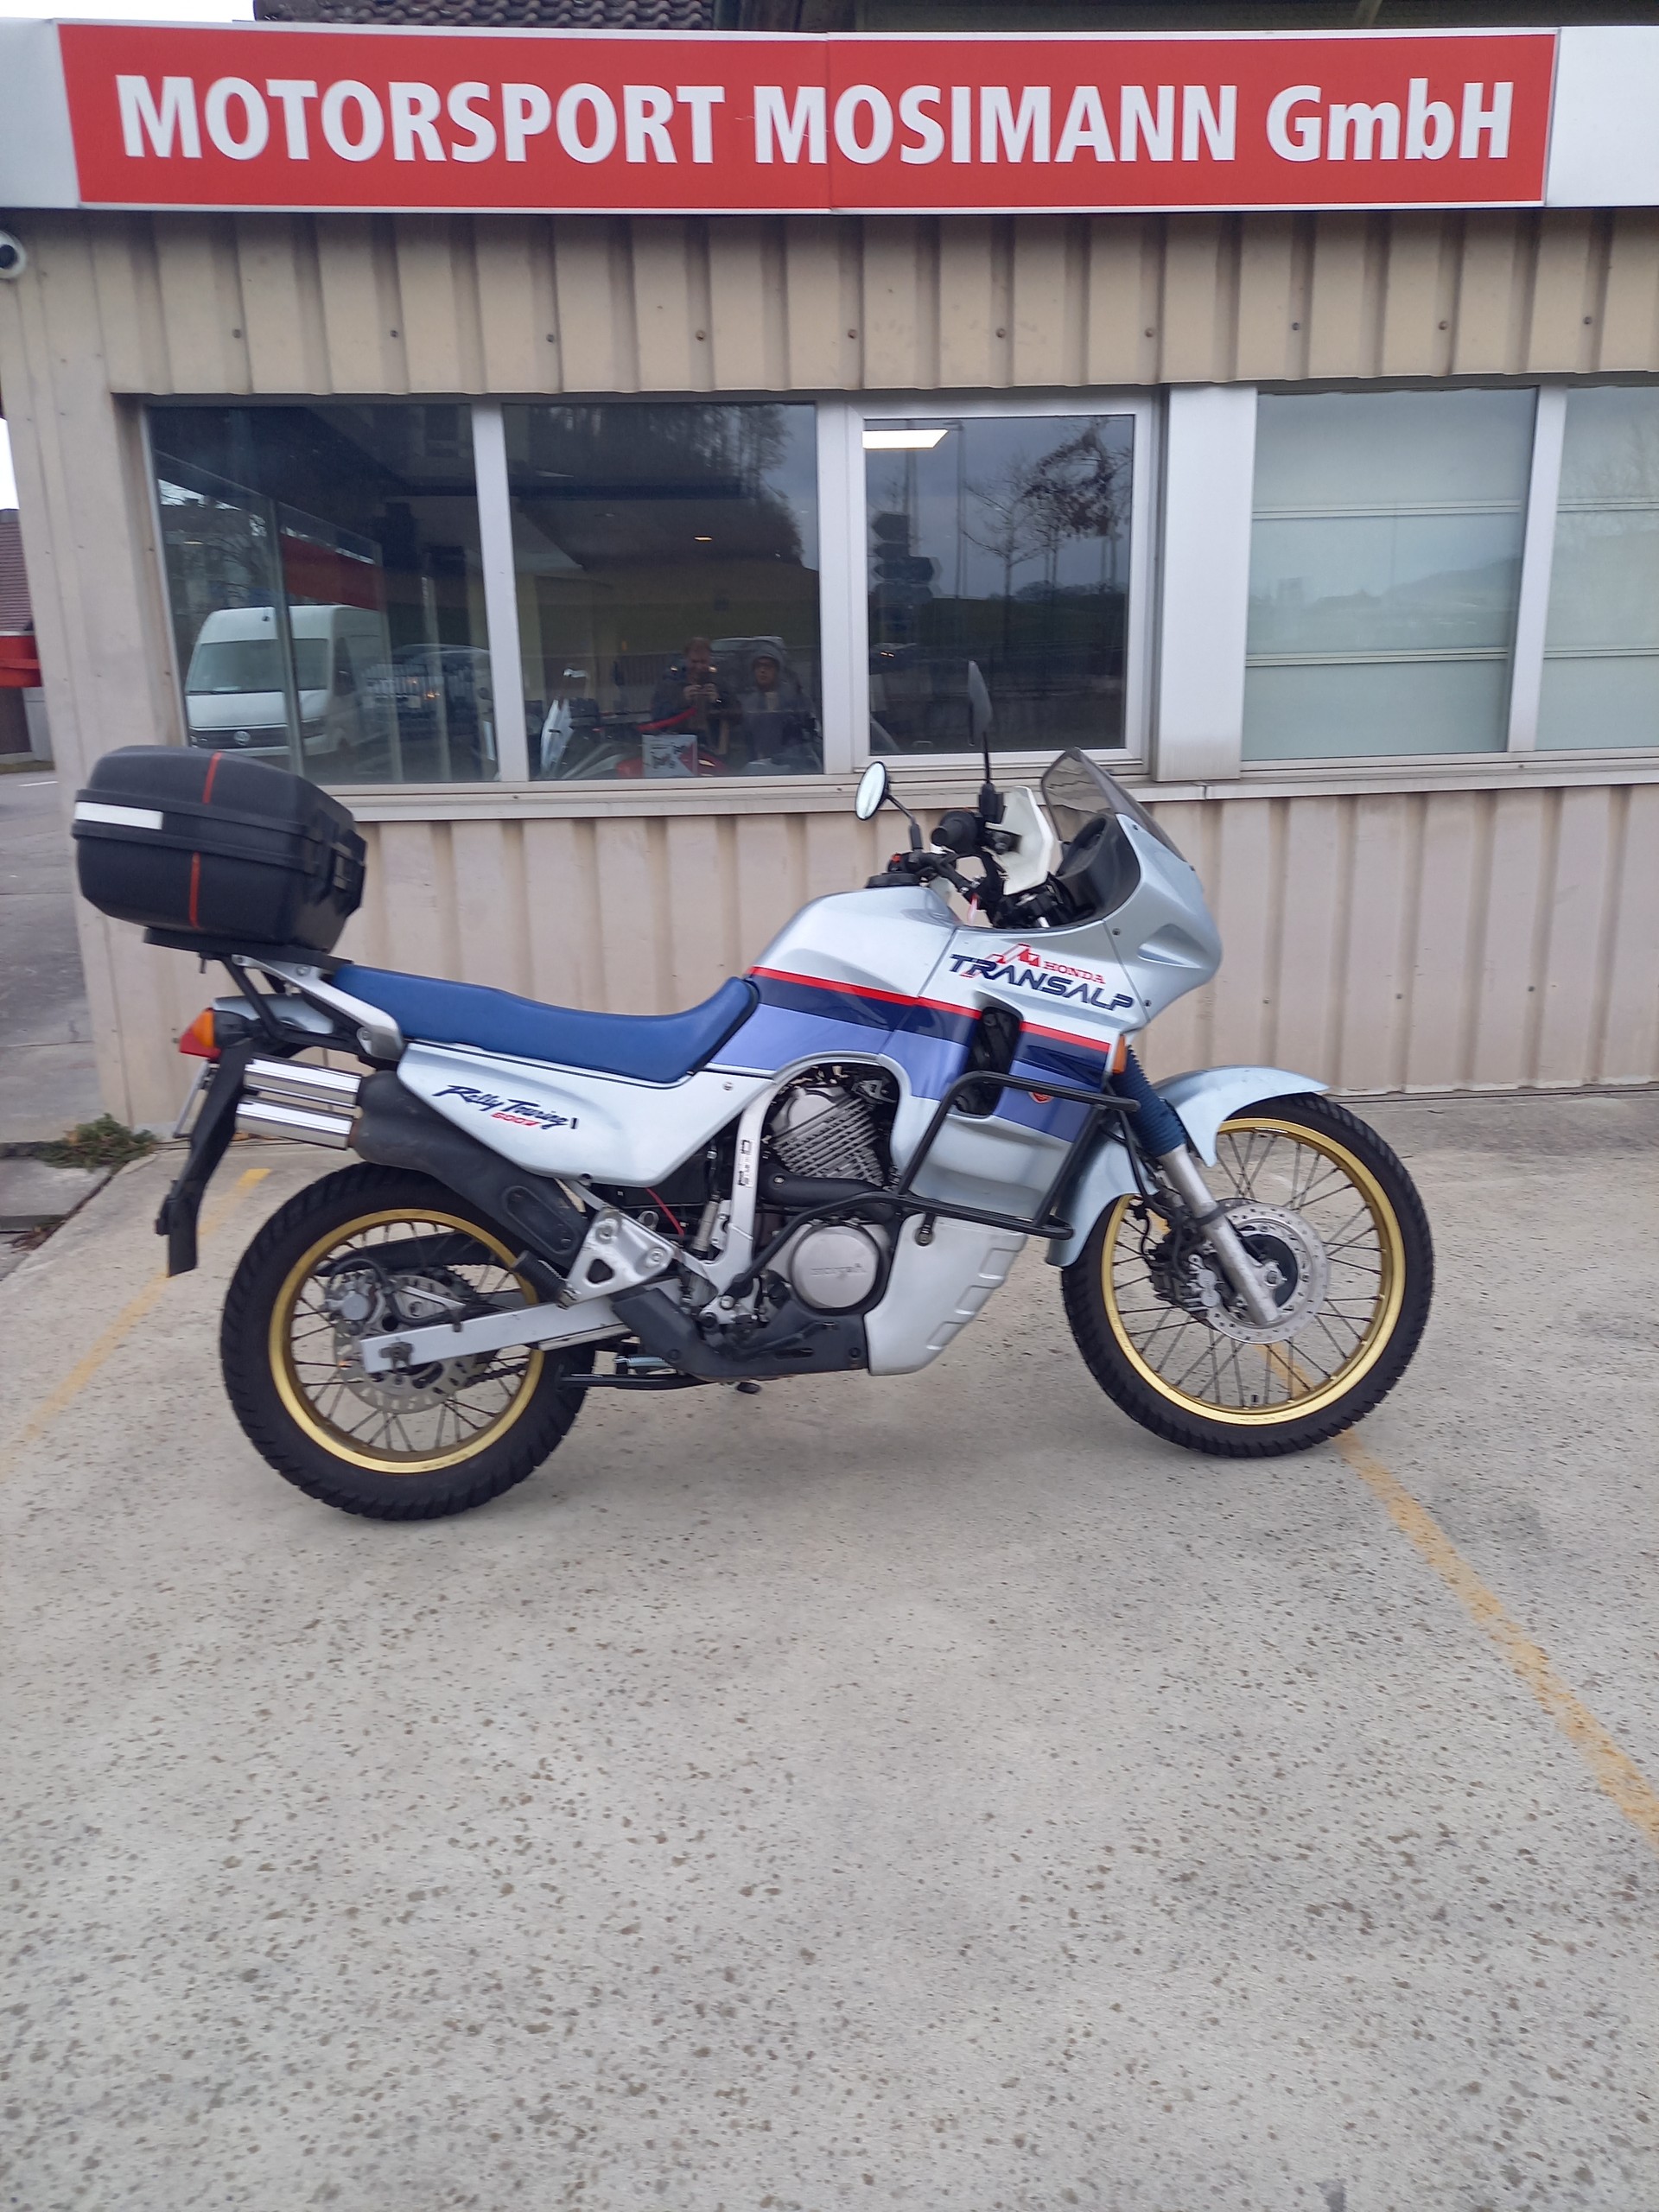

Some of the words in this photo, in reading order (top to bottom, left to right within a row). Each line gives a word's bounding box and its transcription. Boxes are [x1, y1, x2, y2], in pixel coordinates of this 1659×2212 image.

[117, 75, 725, 162] MOTORSPORT
[754, 85, 1236, 164] MOSIMANN
[1267, 78, 1513, 161] GmbH
[949, 954, 1135, 1011] TRANSALP
[1044, 961, 1105, 984] HONDA
[432, 1084, 504, 1111] Rally
